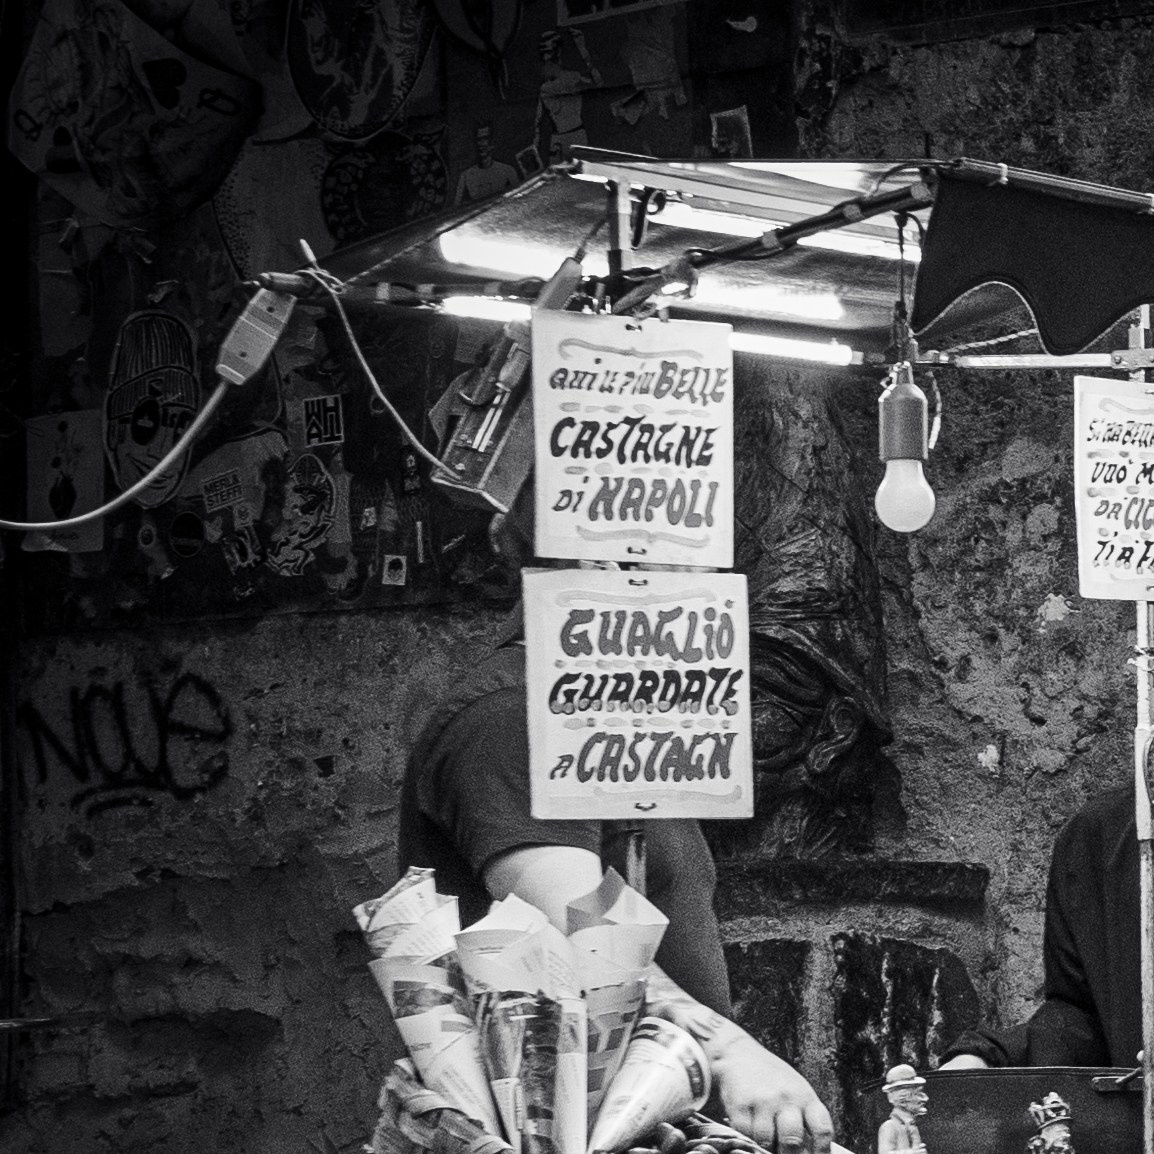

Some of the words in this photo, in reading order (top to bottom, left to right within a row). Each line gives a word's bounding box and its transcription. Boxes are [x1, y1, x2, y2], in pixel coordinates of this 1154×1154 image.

[653, 360, 729, 407] BELLE
[549, 415, 721, 469] CASTAGNE
[588, 476, 719, 528] NAPOLI
[549, 667, 744, 717] GUARDATE
[550, 754, 574, 781] A
[577, 731, 739, 784] CASTAGN
